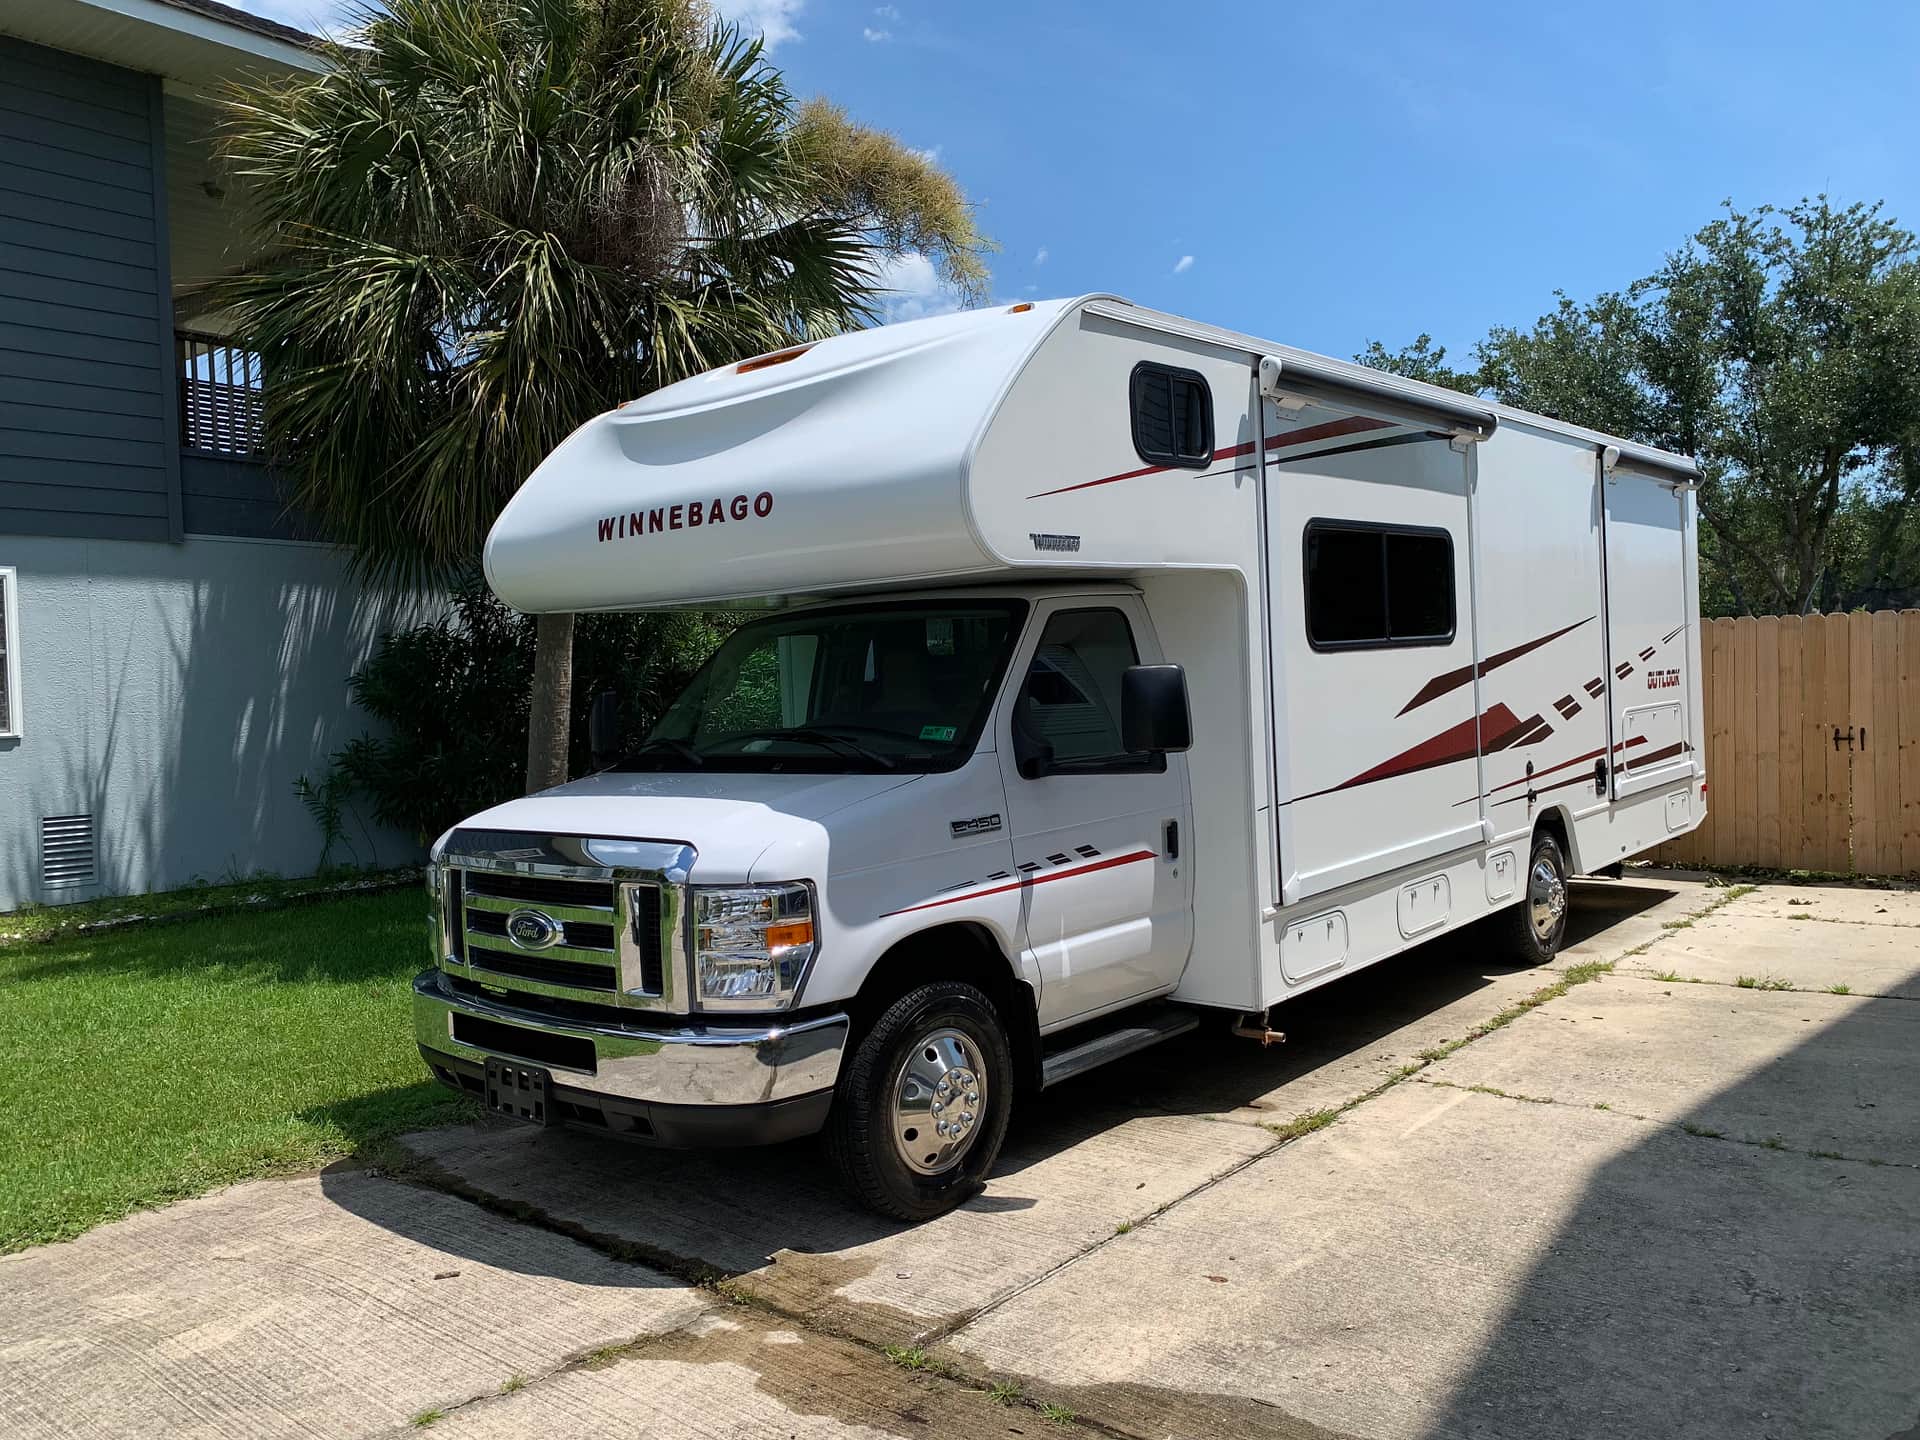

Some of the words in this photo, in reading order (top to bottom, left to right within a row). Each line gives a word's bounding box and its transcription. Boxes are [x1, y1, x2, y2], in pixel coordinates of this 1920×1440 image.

[598, 491, 773, 542] WINNEBAGO
[1647, 668, 1680, 690] OUTLOOK
[515, 920, 538, 938] Ford
